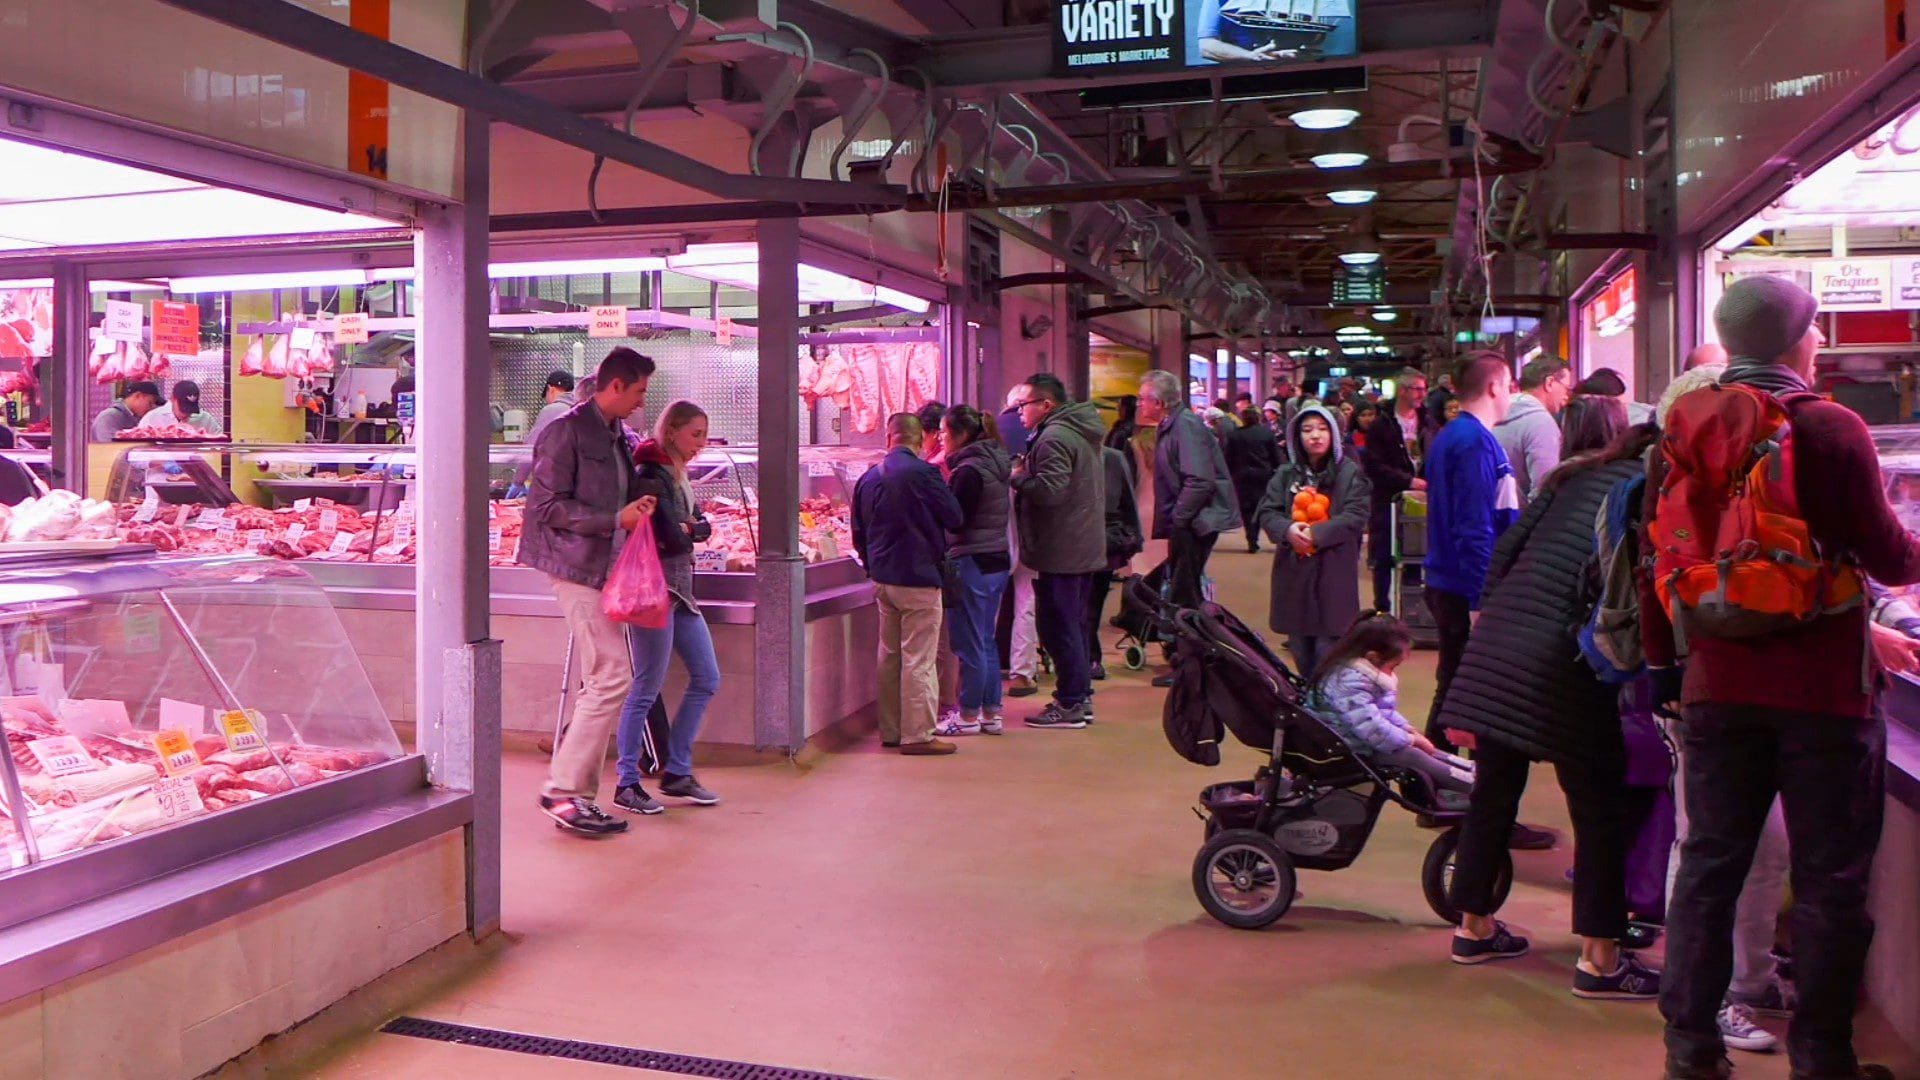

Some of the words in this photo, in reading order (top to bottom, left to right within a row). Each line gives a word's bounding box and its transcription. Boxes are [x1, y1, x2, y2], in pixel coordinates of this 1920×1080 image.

[1062, 0, 1174, 43] VARIETY
[1068, 52, 1117, 66] MELBOURNE'S
[1119, 47, 1170, 62] MARKETPLACE
[1841, 264, 1861, 277] Ox
[1823, 275, 1880, 290] Tongues
[341, 316, 361, 324] CASH
[596, 321, 619, 329] ONLY
[341, 327, 362, 335] ONLY
